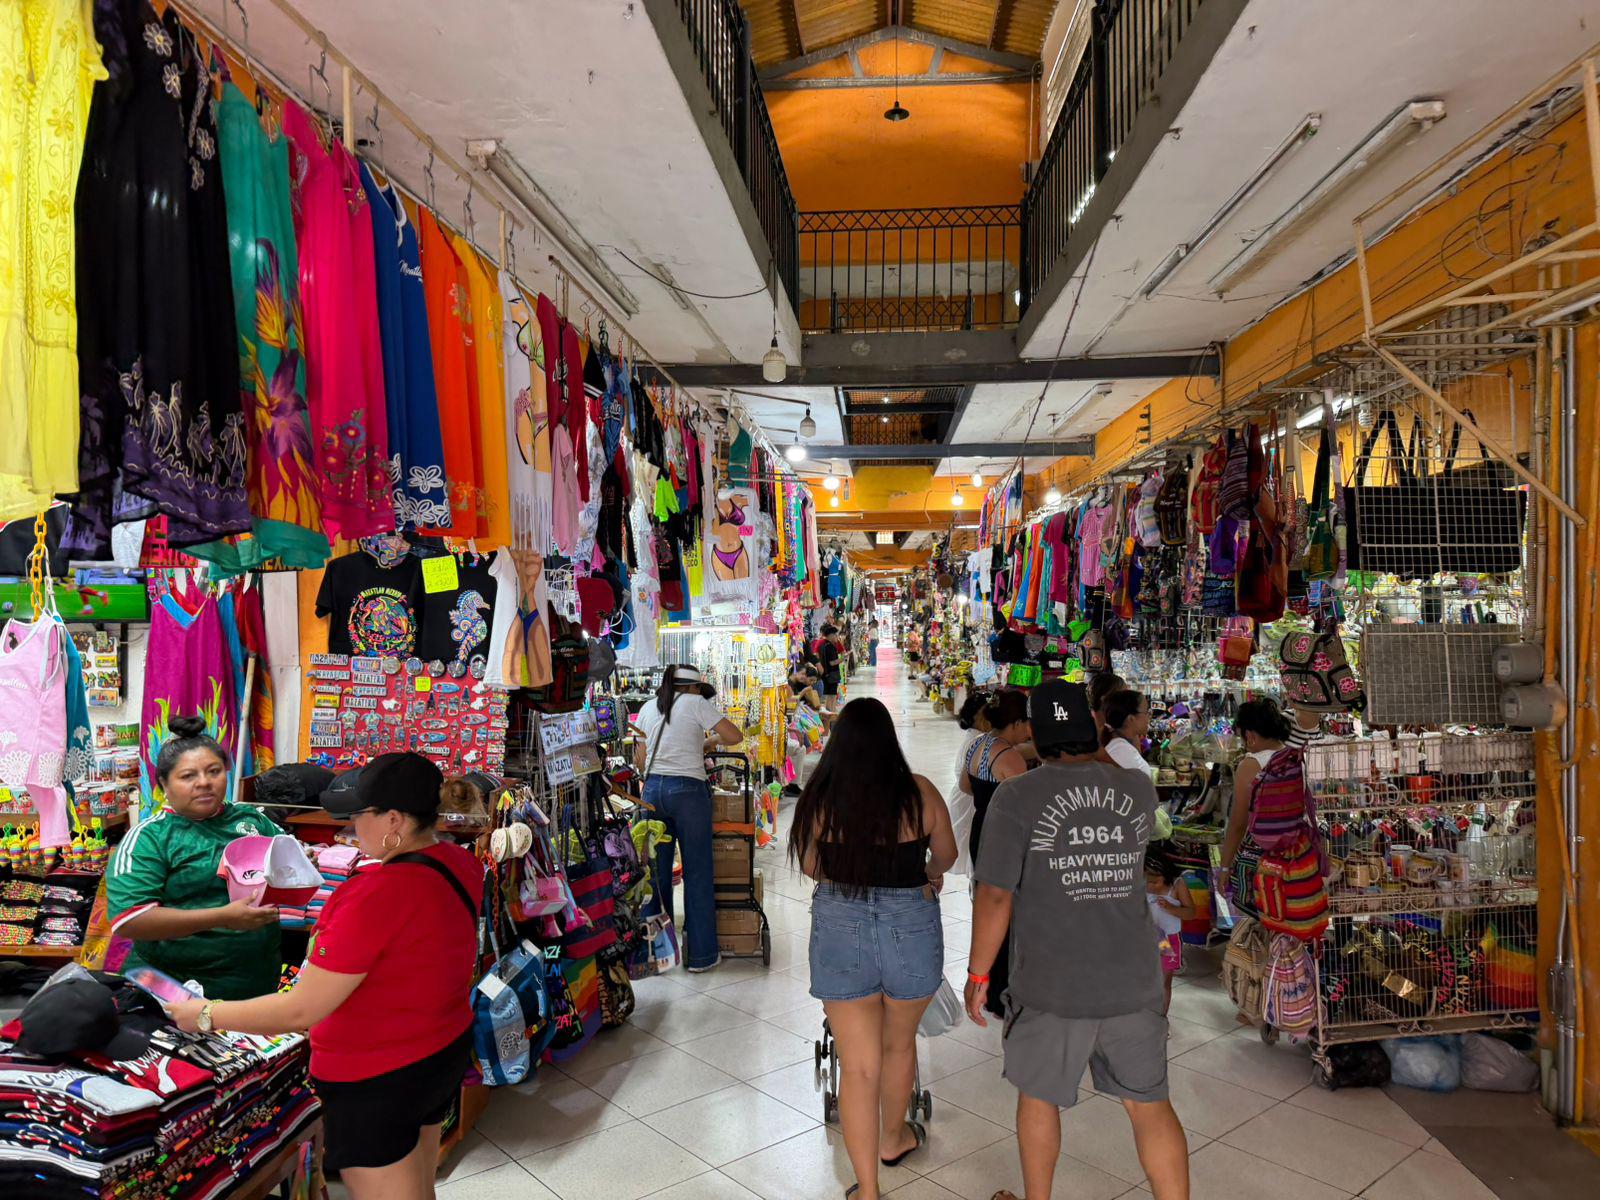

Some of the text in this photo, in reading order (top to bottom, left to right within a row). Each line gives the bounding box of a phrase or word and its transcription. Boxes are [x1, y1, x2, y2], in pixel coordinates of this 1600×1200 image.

[1053, 702, 1068, 720] LA
[1030, 785, 1134, 852] MUHAMMAD
[1068, 825, 1125, 845] 1964
[1049, 851, 1141, 870] HEAVYWEIGHT
[1061, 868, 1134, 885] CHAMPION
